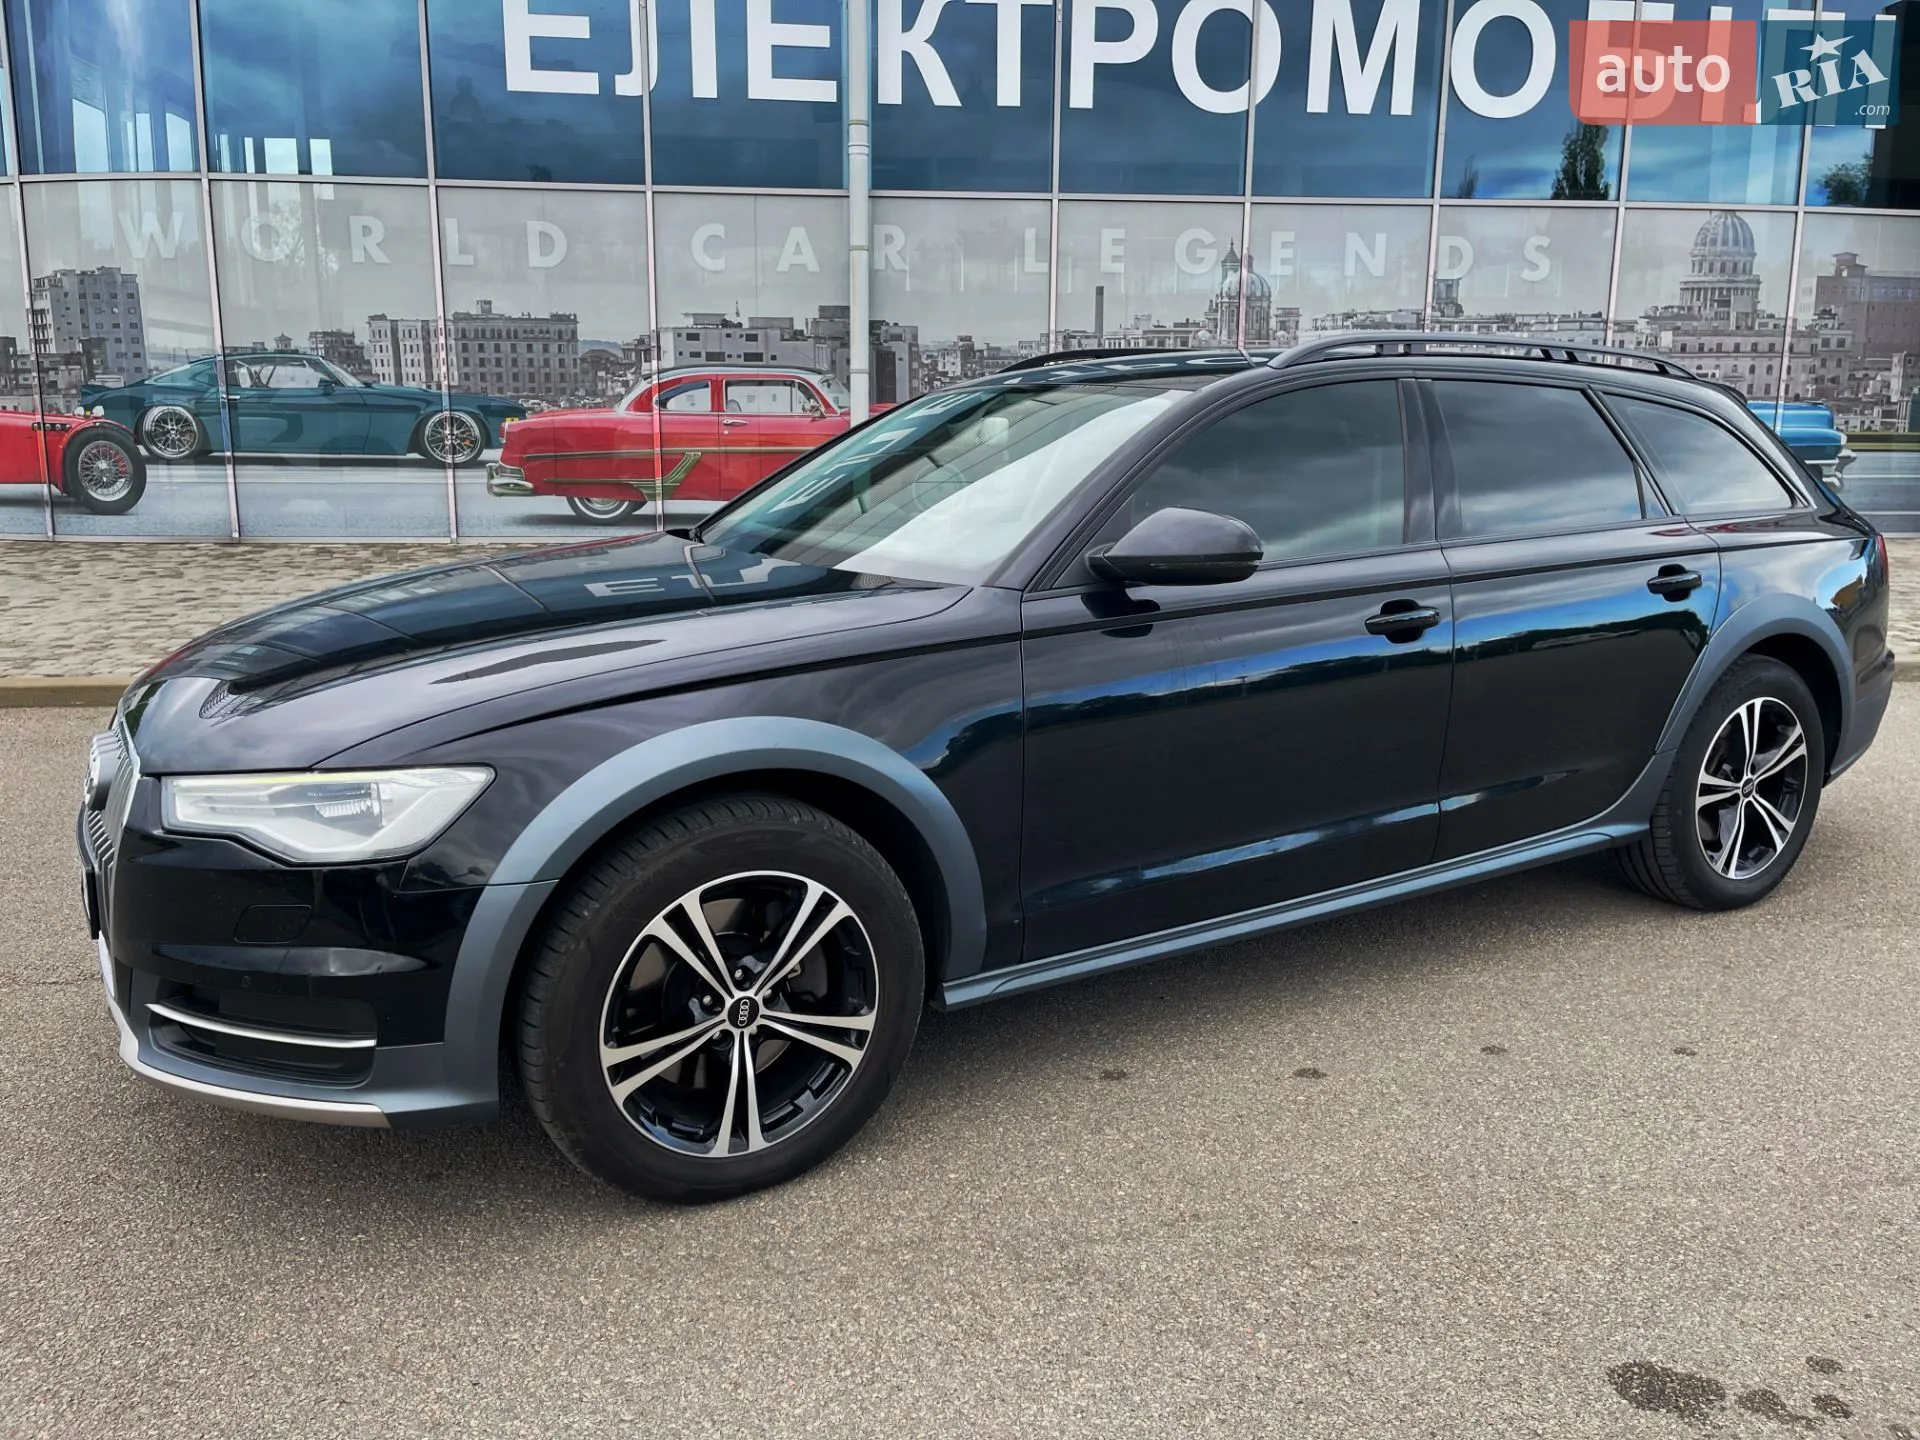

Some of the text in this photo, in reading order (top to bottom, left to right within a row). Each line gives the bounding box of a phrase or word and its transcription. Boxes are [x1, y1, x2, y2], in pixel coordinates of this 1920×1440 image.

[117, 210, 1553, 283] WORLD CAR LEGENDS
